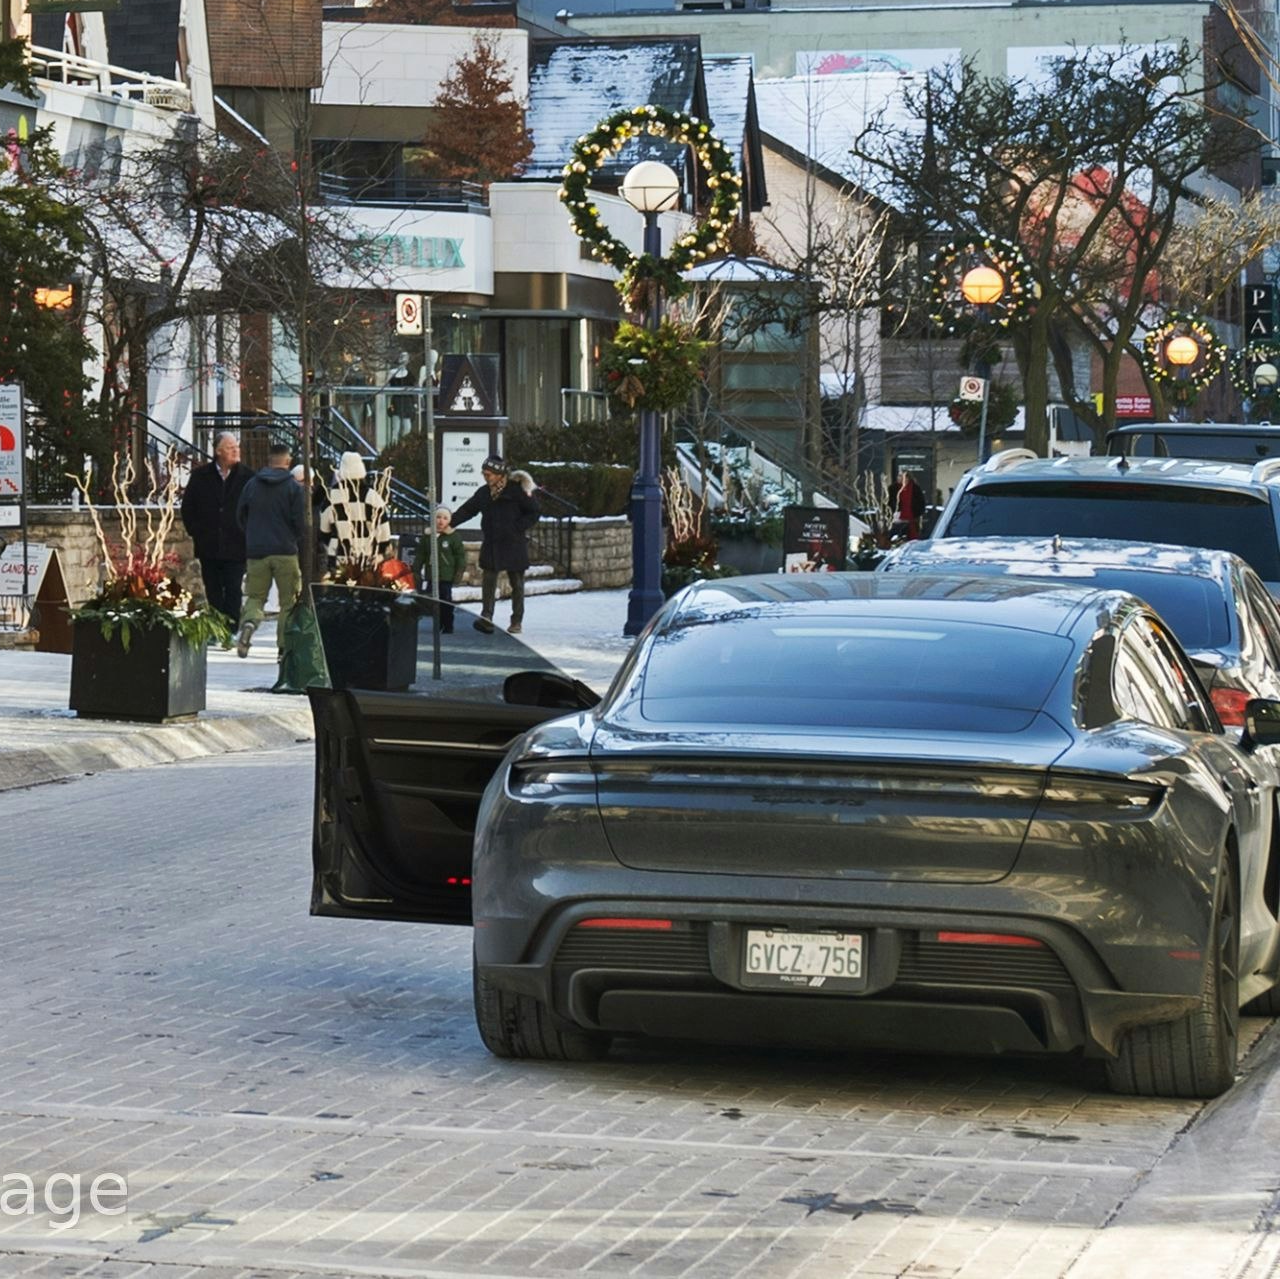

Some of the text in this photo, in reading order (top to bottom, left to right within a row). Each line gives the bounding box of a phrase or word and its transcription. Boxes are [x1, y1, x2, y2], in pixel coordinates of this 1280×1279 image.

[0, 563, 39, 576] CANDES
[780, 933, 829, 944] ONTARIO
[748, 943, 860, 975] GVCZ 756
